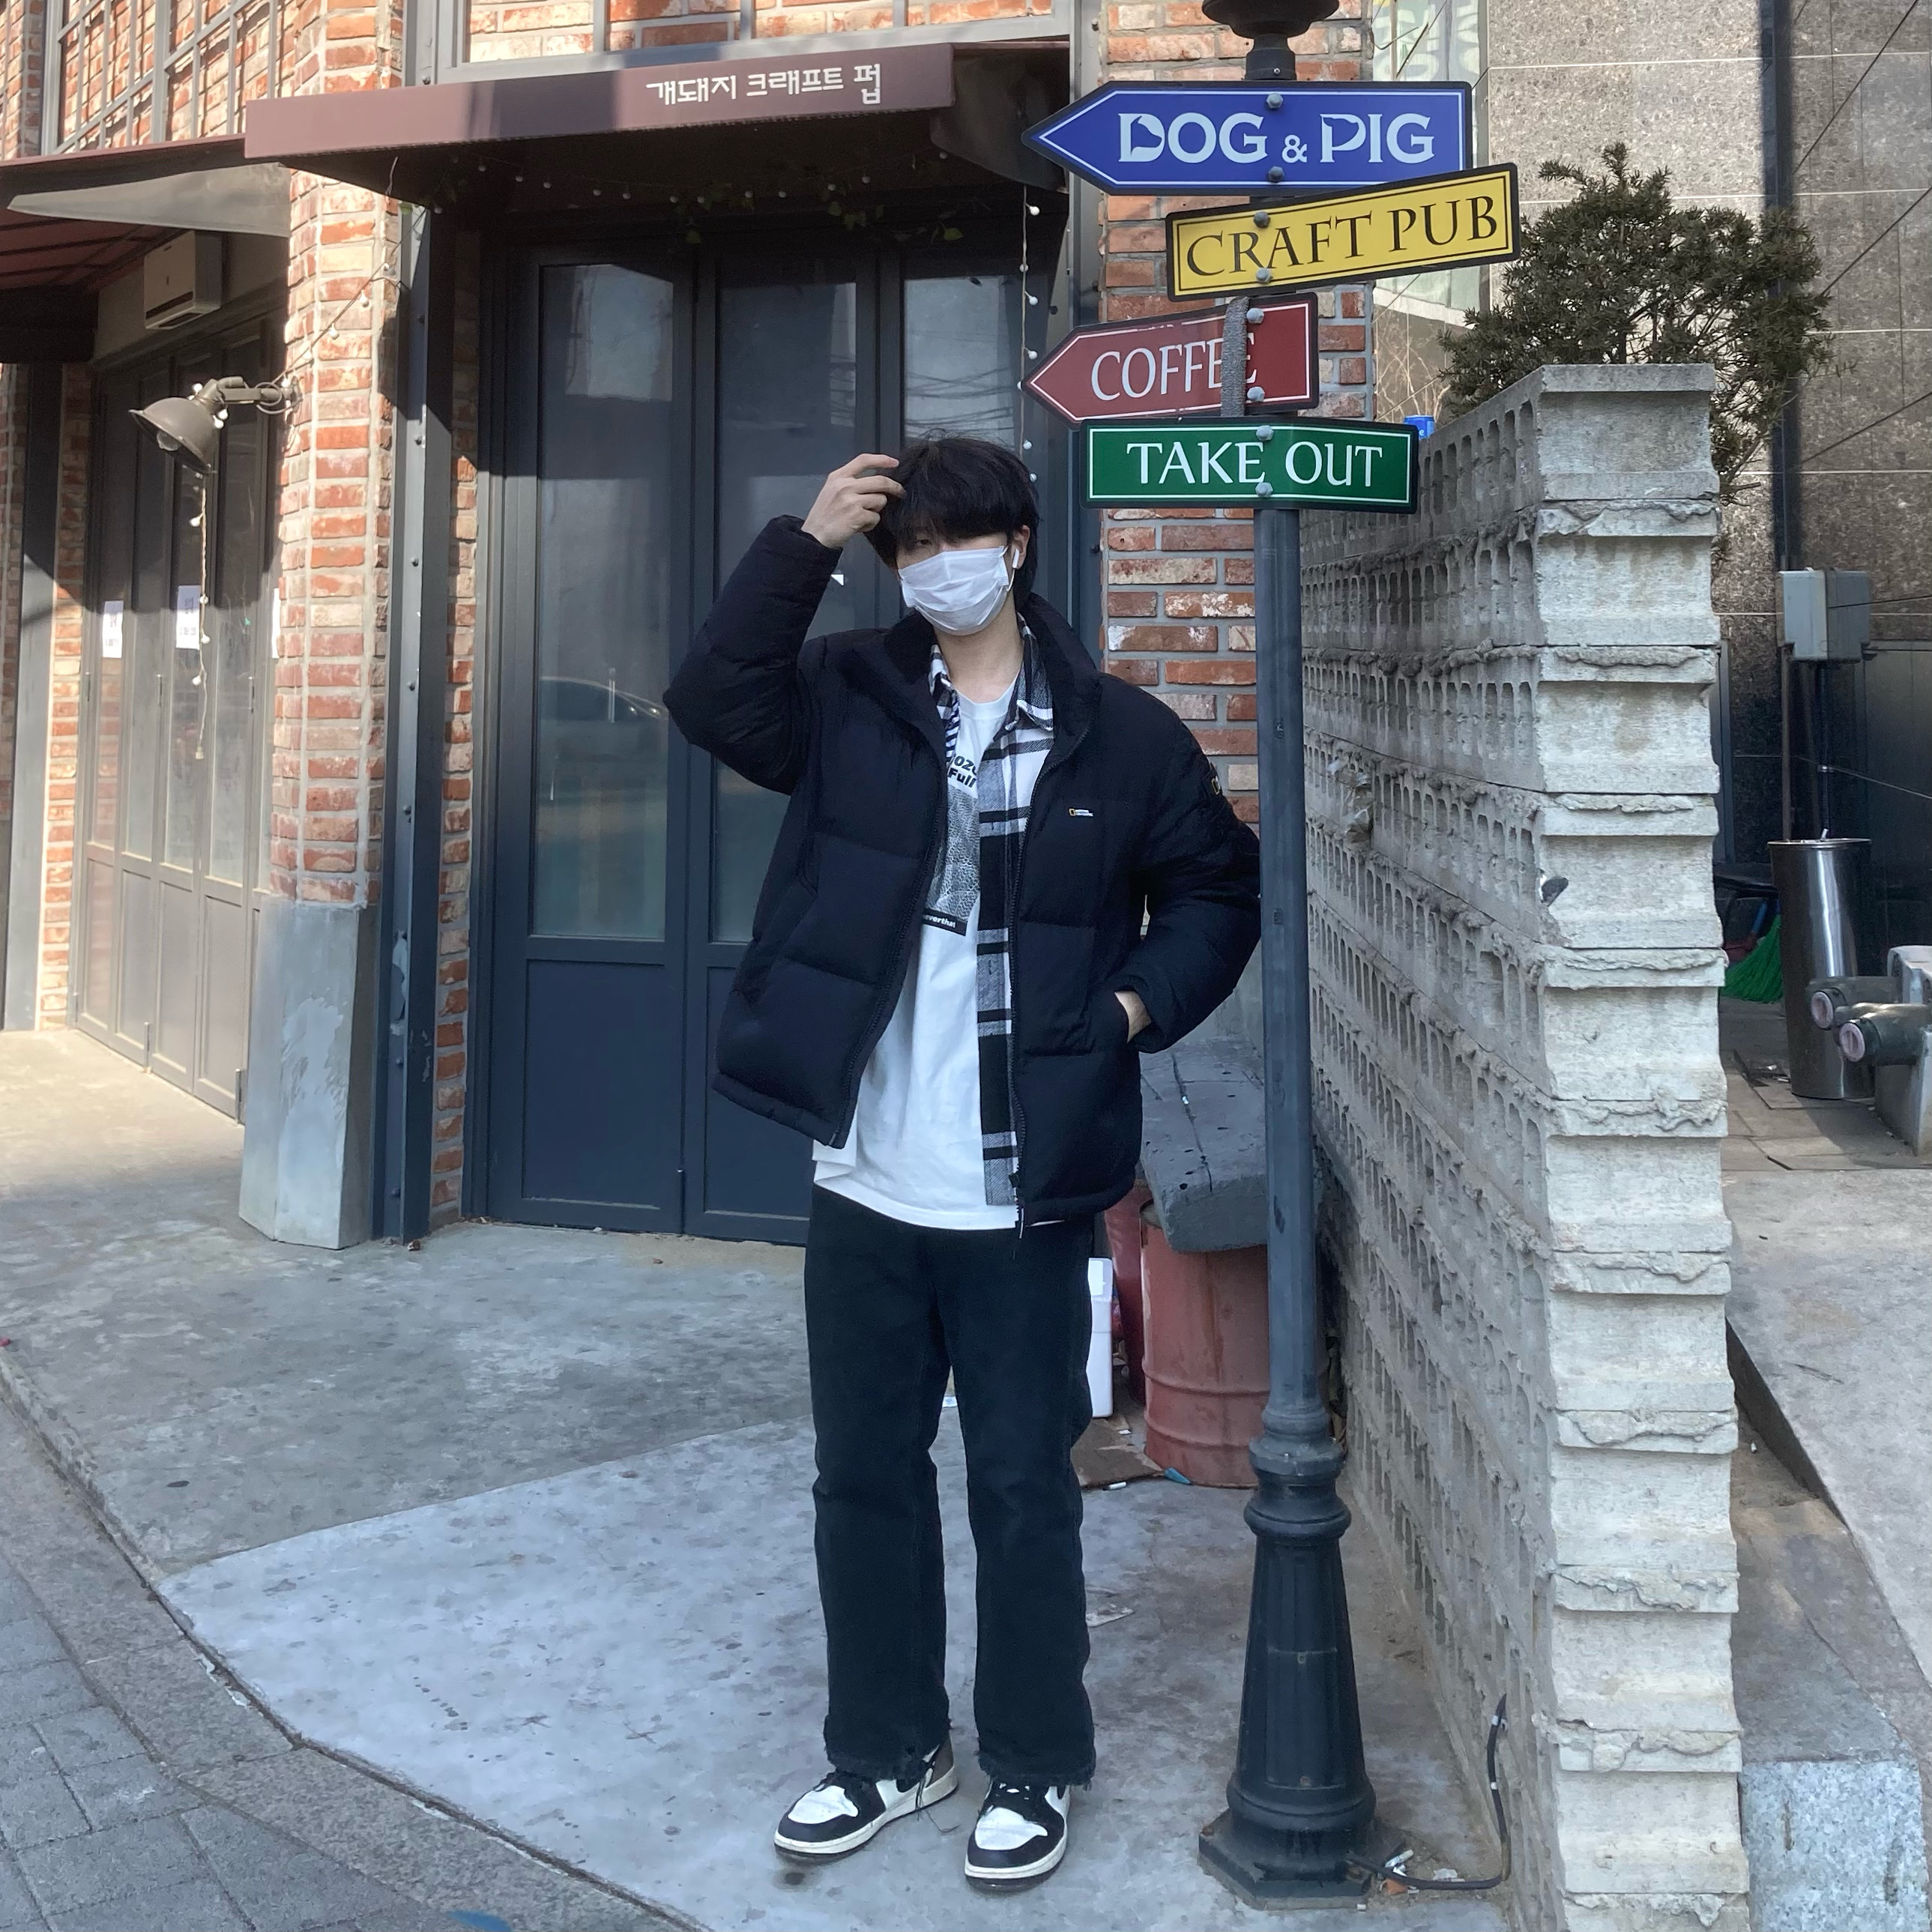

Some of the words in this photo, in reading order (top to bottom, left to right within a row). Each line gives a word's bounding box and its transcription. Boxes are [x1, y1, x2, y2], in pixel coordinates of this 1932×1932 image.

[646, 75, 737, 105] 개돼지
[746, 67, 844, 95] 크래프트
[854, 64, 881, 104] 펍
[1118, 112, 1268, 163] DOG
[1282, 134, 1308, 163] &
[1319, 112, 1435, 164] PIG
[1186, 211, 1373, 276] CRAFT
[1386, 195, 1497, 253] PUB
[1126, 441, 1266, 484] TAKE
[1285, 441, 1383, 487] OUT
[948, 767, 977, 788] Full
